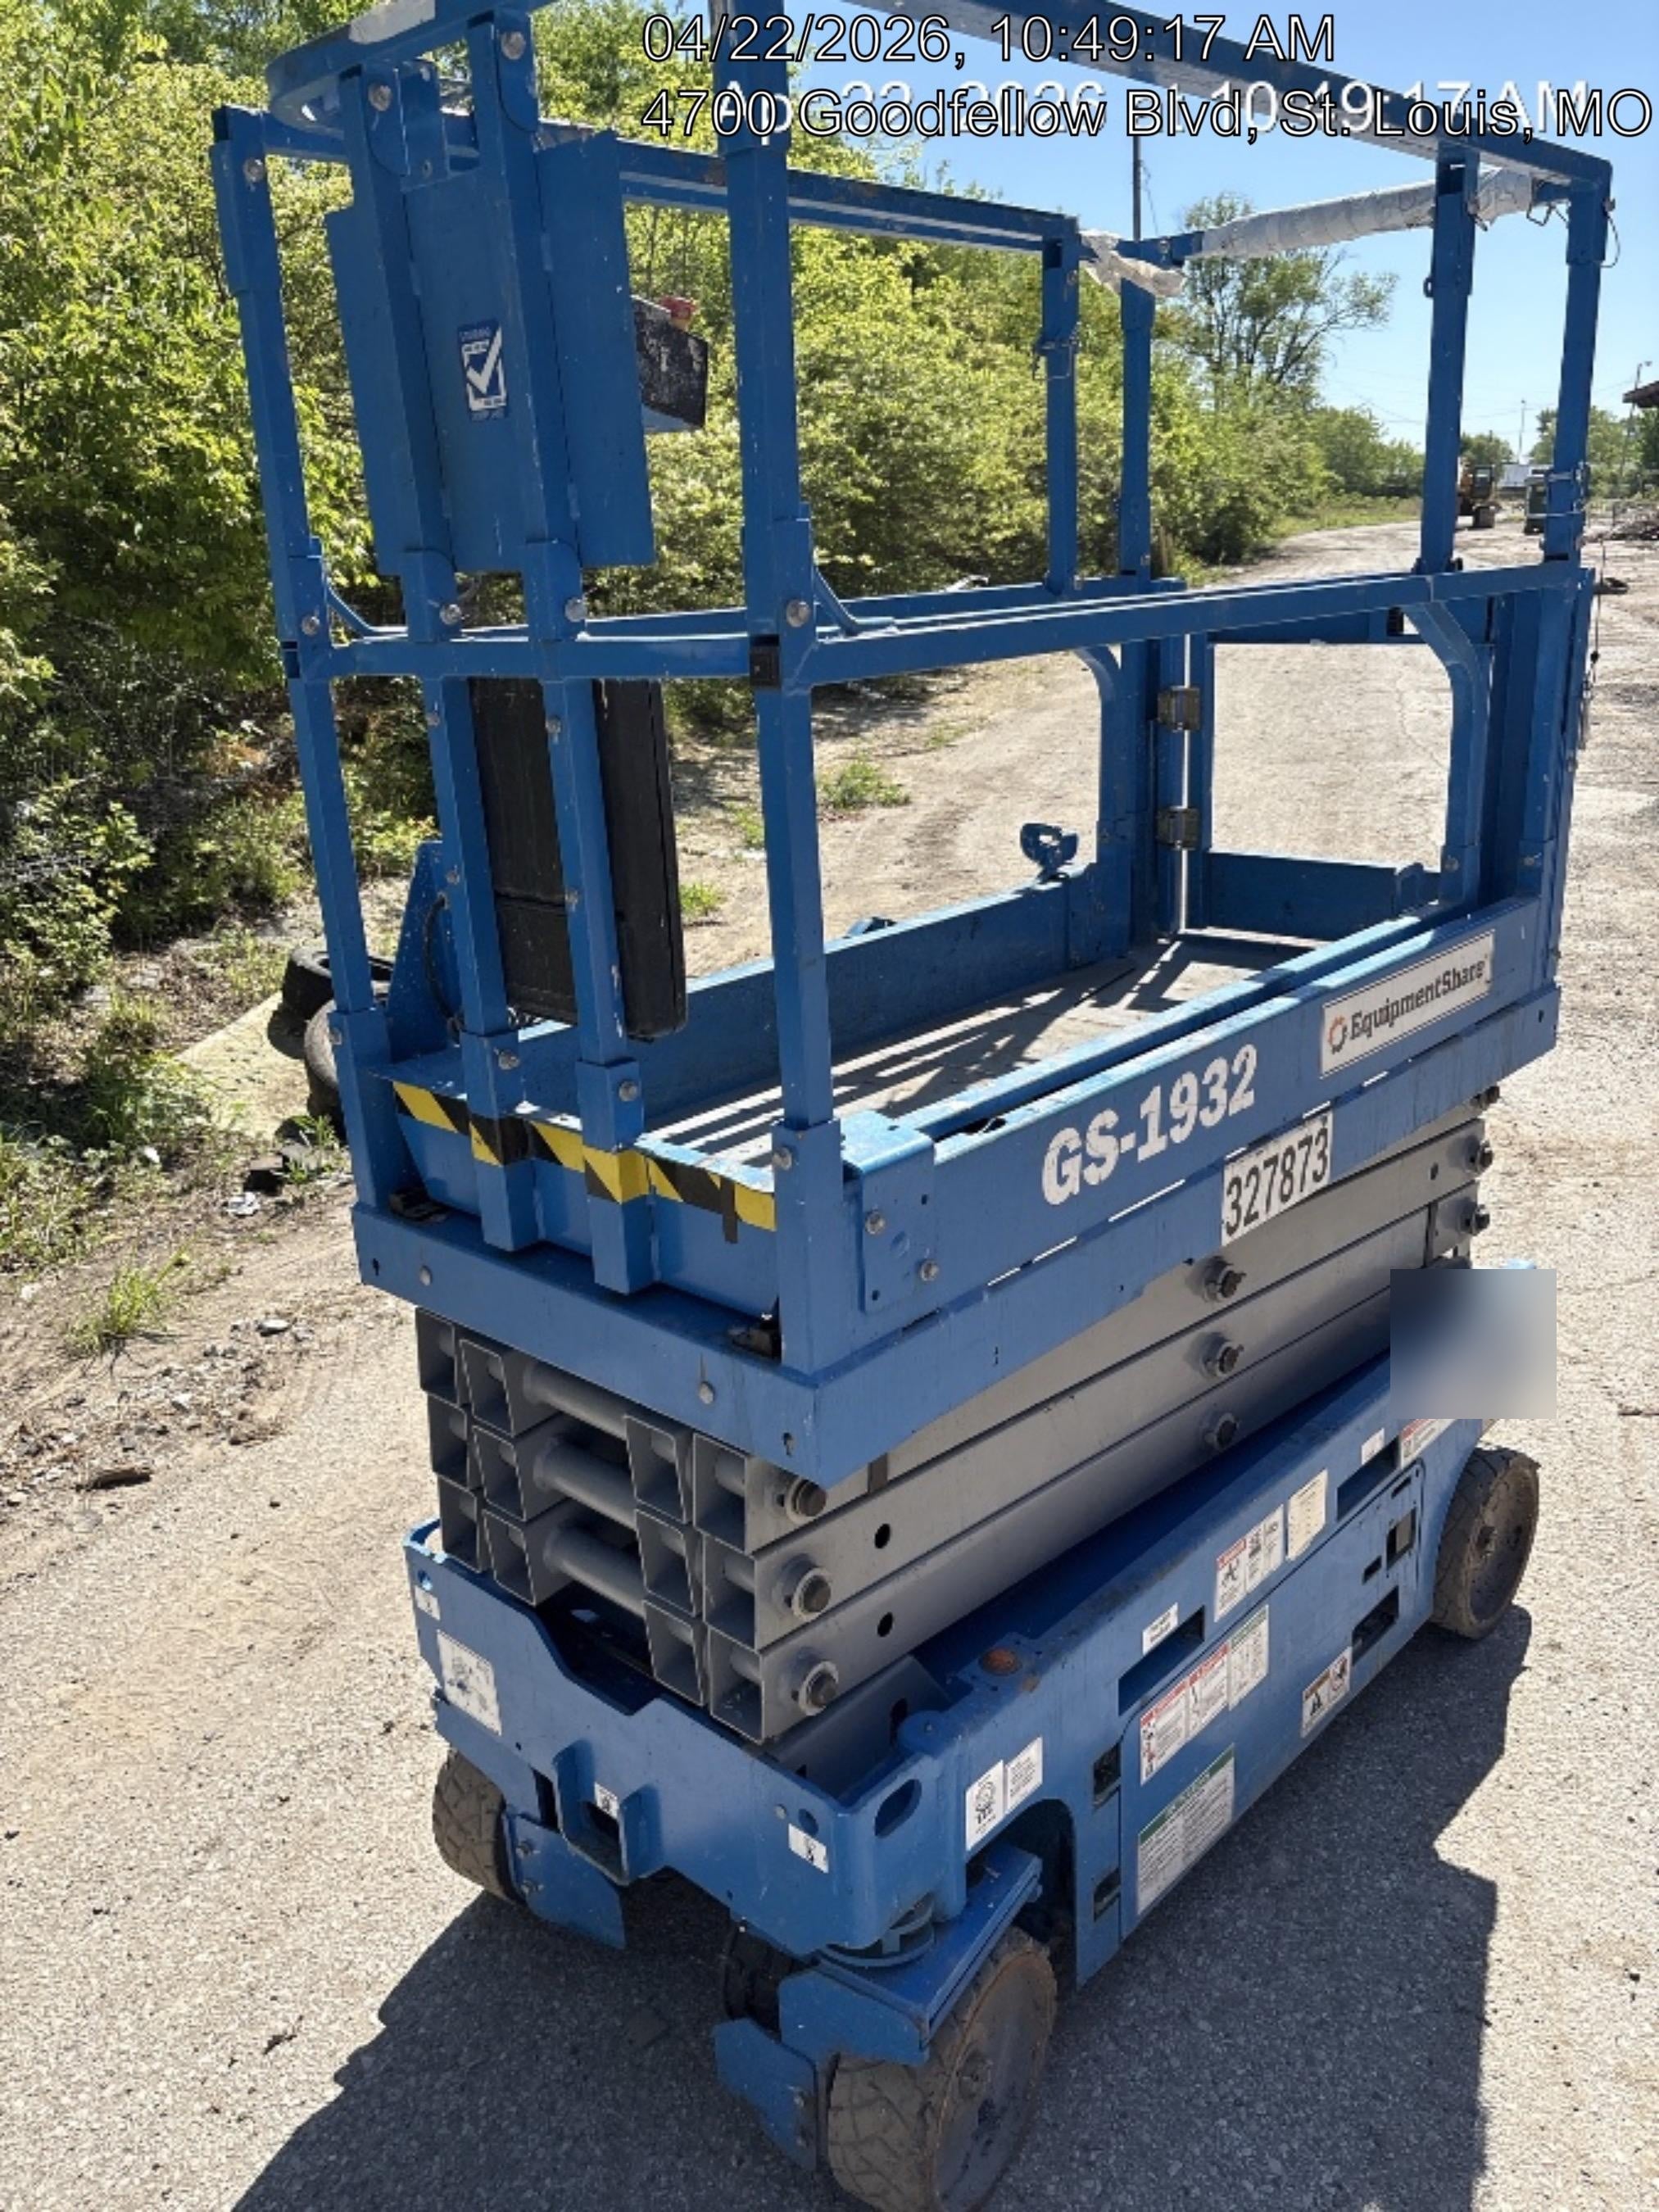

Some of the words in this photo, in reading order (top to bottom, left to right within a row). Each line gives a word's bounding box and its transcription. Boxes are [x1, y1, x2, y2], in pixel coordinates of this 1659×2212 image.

[1349, 959, 1485, 1041] EquipmentShare
[1042, 1043, 1258, 1206] GS-1932
[1225, 1132, 1330, 1237] 327873
